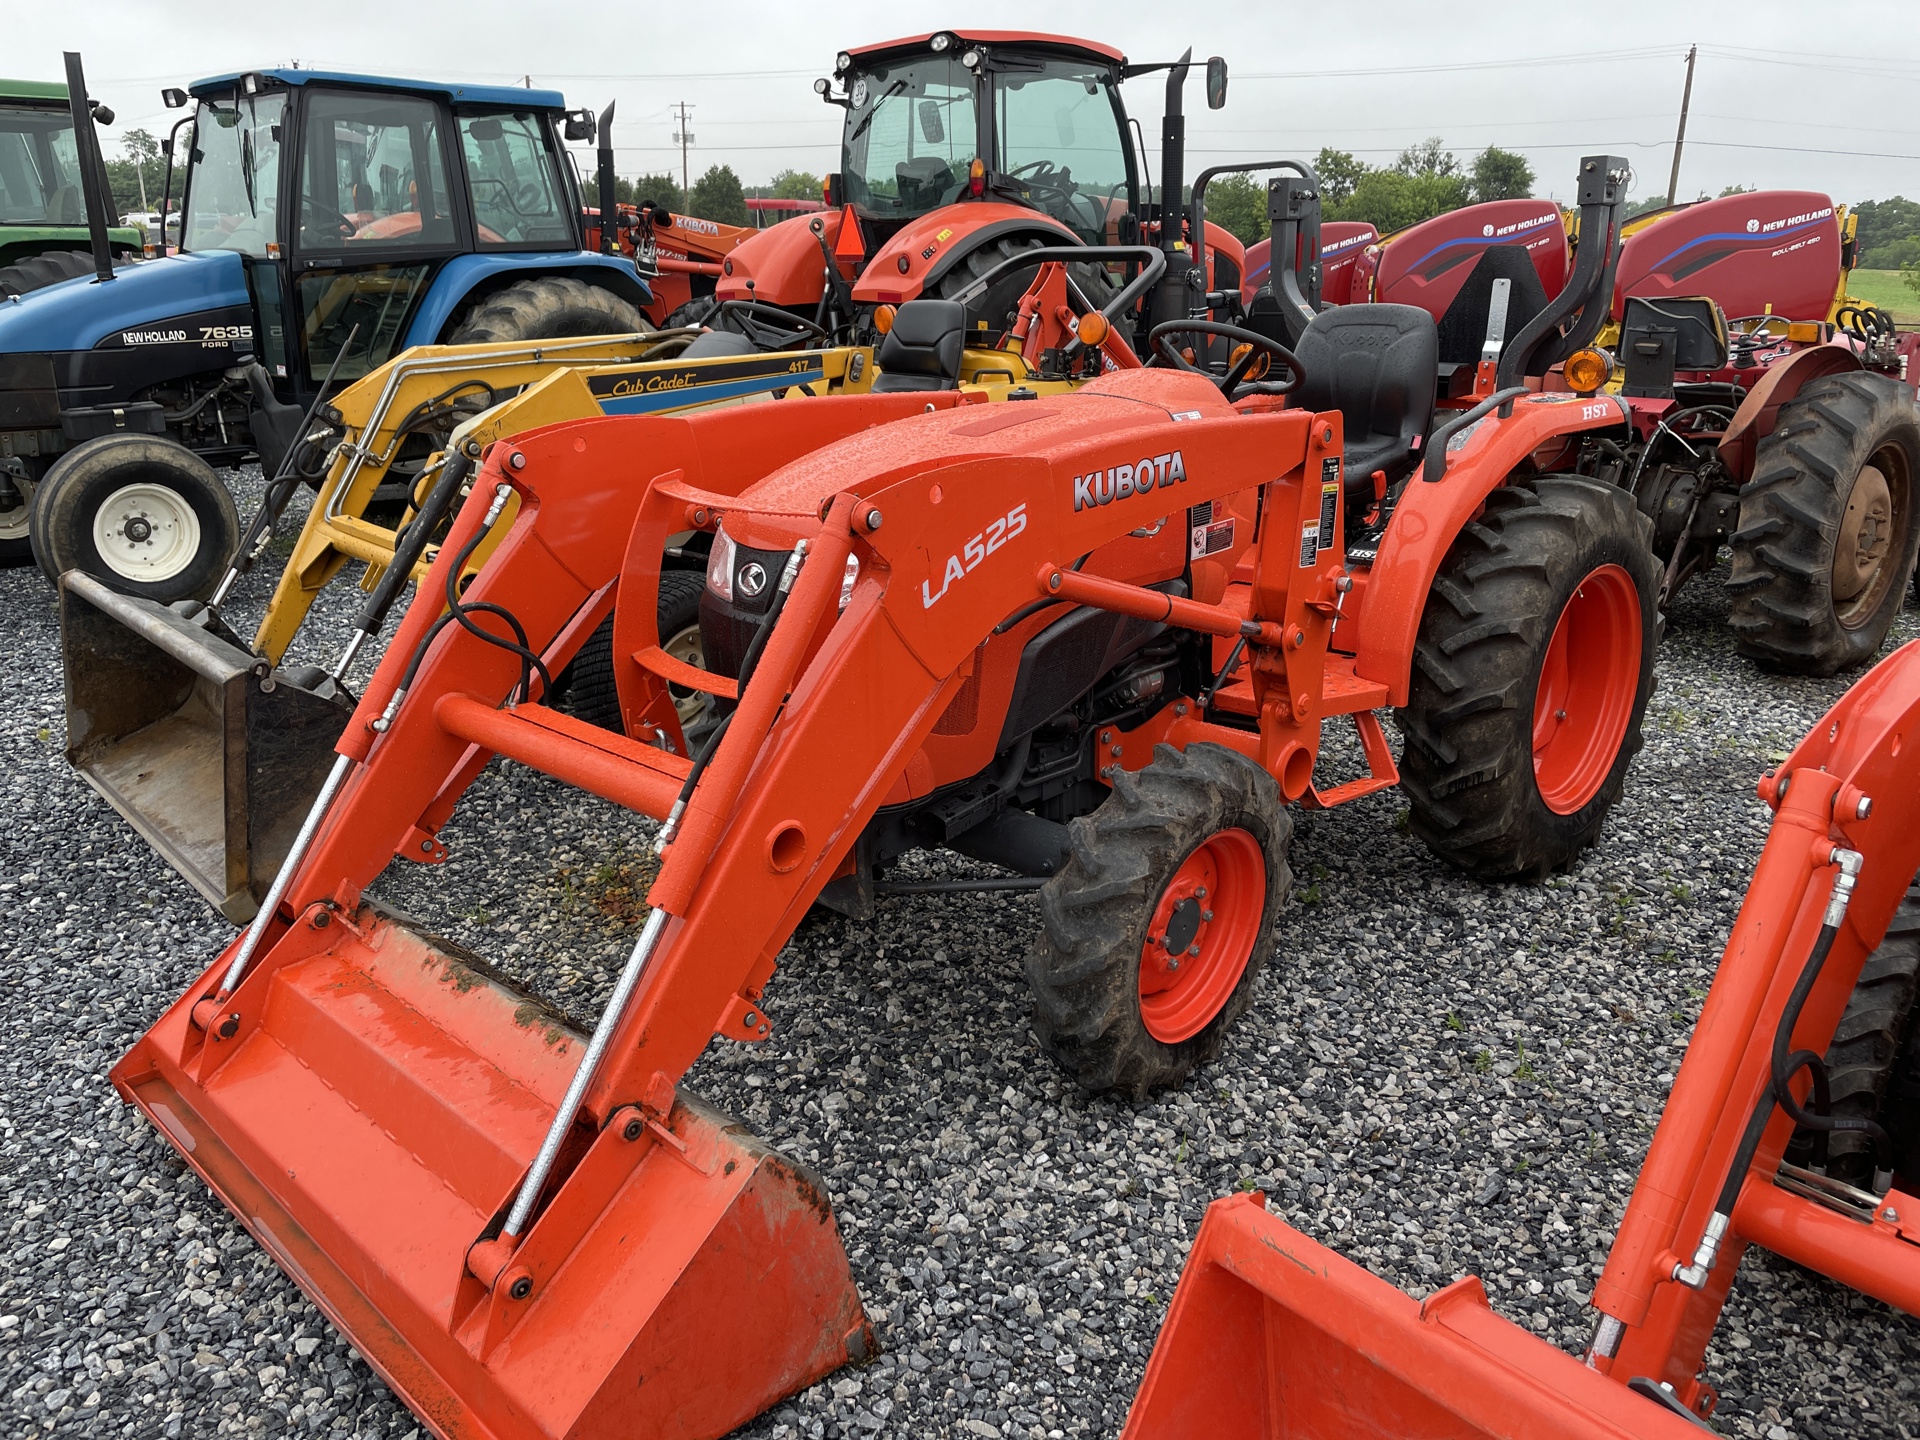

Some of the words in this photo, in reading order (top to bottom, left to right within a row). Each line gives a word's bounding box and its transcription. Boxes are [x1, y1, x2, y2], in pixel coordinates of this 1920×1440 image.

[676, 217, 719, 236] KUBOTA
[1496, 224, 1516, 236] NEW
[1517, 214, 1555, 230] HOLLAND
[1763, 219, 1786, 232] NEW
[1787, 208, 1832, 226] HOLLAND
[1322, 242, 1339, 254] NEW
[1340, 232, 1372, 248] HOLLAND
[1771, 241, 1806, 257] ROLL-BELT
[123, 332, 144, 344] NEW
[144, 330, 187, 342] HOLLAND
[199, 325, 253, 340] 7635
[201, 341, 229, 349] FORD
[788, 360, 809, 373] 417
[612, 378, 643, 396] Cub
[646, 372, 697, 393] Cadet
[1582, 403, 1609, 420] HST
[1073, 450, 1187, 513] KUBOTA
[922, 503, 1027, 610] LA525
